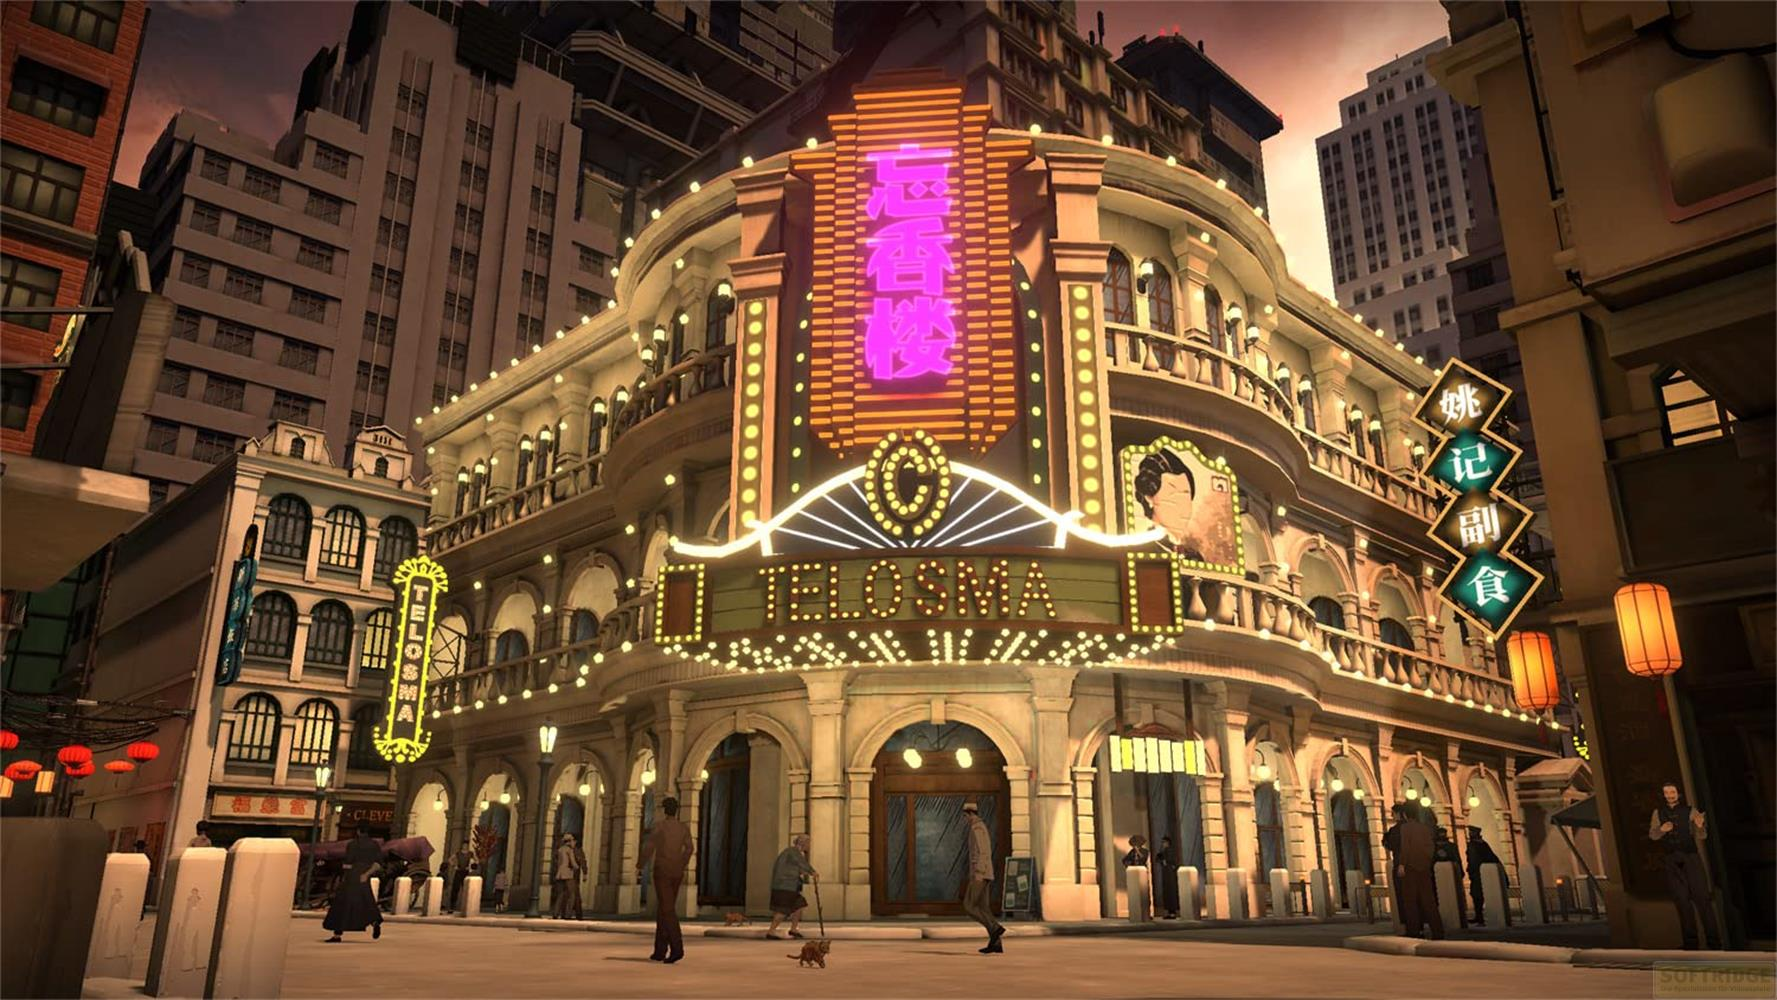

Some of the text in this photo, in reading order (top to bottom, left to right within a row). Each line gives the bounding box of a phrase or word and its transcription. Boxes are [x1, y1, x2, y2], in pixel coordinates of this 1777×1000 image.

[865, 144, 956, 380] 忘香楼
[1438, 382, 1510, 607] 姚记副食
[396, 584, 430, 723] TELOSMA
[757, 557, 1058, 623] TELOSMA
